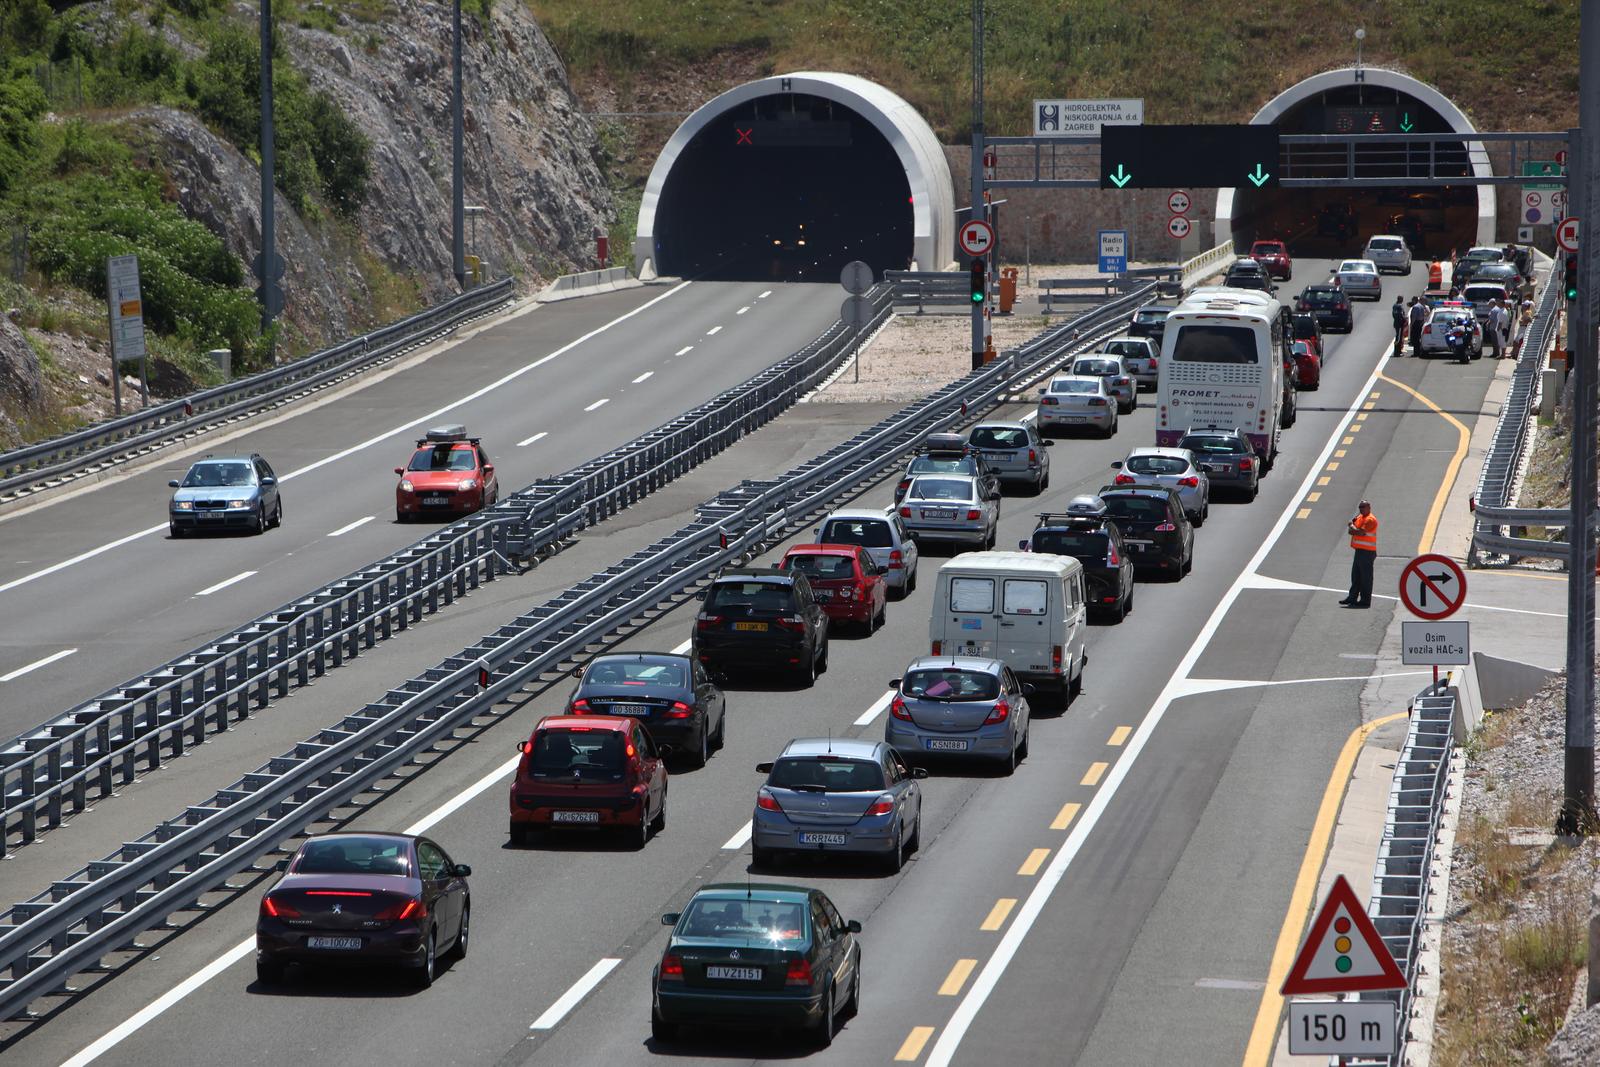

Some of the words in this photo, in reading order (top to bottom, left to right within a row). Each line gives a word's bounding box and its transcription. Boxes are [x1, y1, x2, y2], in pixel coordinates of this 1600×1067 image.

[1064, 104, 1121, 112] HIDROELEKTRA
[1064, 123, 1095, 131] ZAGREB
[1171, 389, 1220, 398] PROMET
[1425, 633, 1446, 642] Osim
[1408, 645, 1433, 654] vozila
[1436, 645, 1464, 654] HAC-a
[1302, 1014, 1346, 1041] 150
[1361, 1021, 1380, 1041] m
